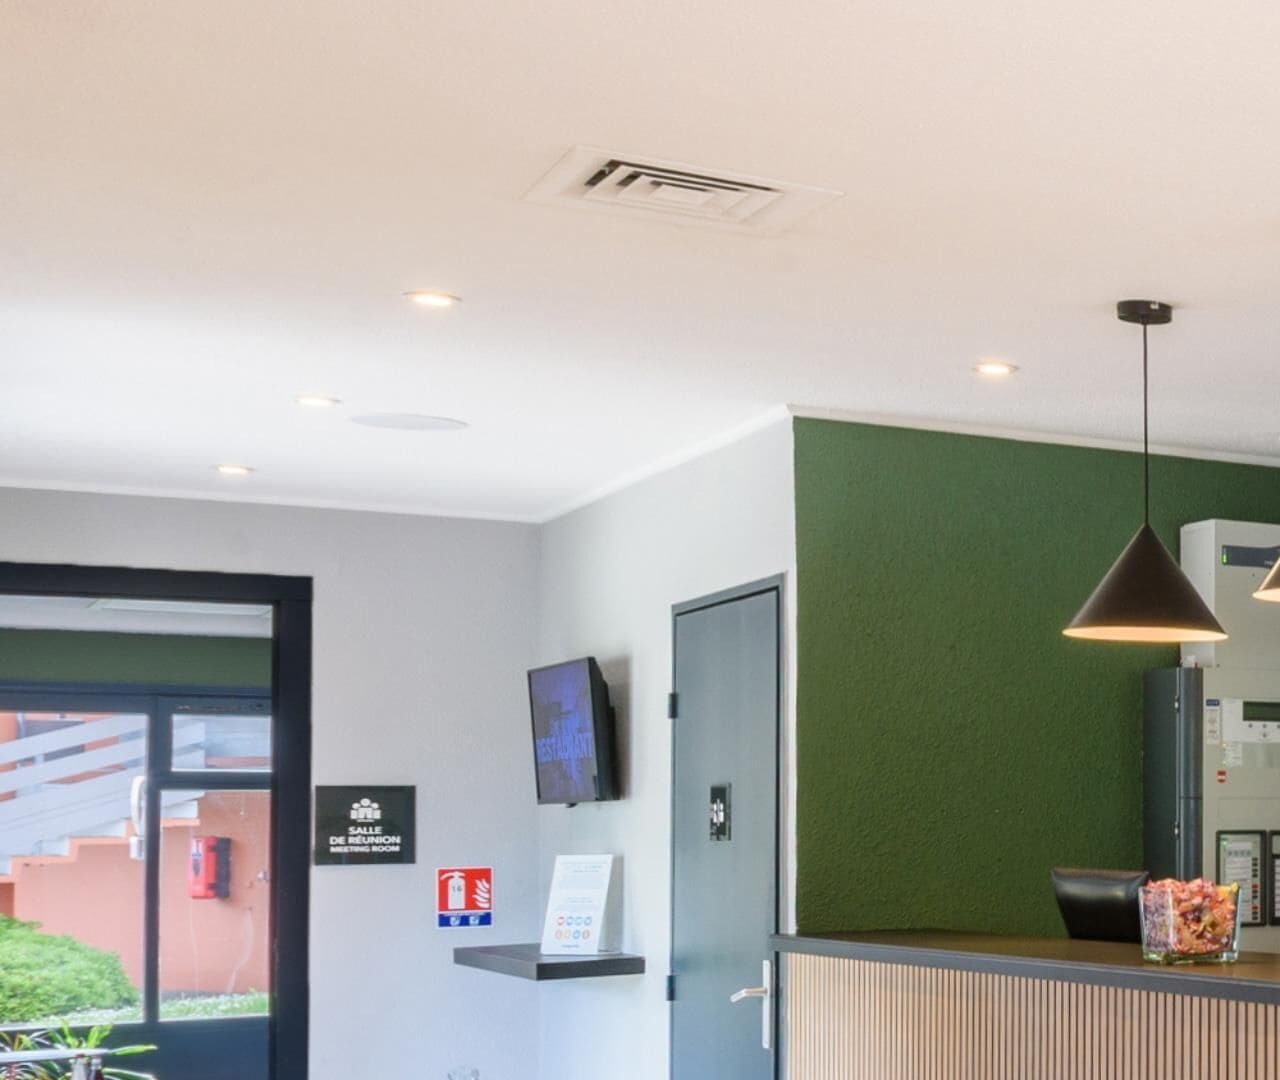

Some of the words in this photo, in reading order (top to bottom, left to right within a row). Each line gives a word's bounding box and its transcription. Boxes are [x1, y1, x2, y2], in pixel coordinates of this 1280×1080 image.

[348, 826, 383, 835] SALLE
[329, 836, 346, 845] DE
[348, 834, 401, 844] RÉUNION
[329, 845, 370, 853] MEETING
